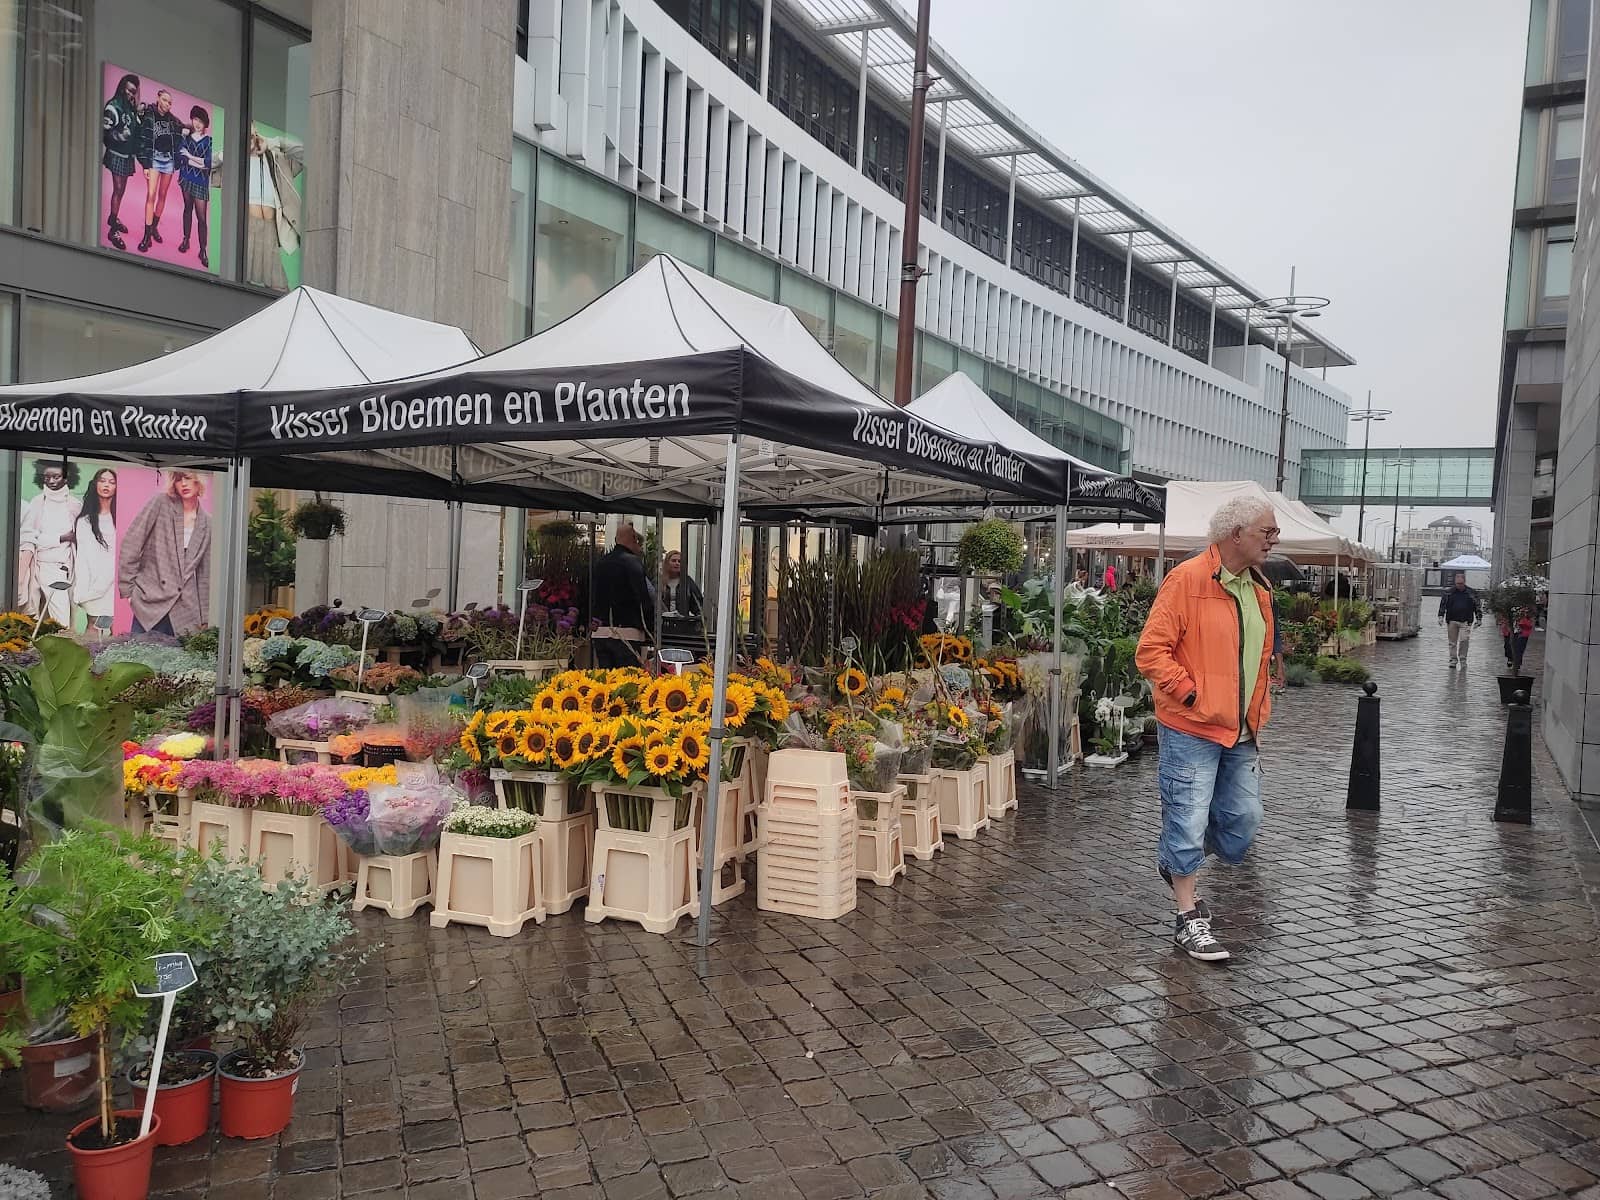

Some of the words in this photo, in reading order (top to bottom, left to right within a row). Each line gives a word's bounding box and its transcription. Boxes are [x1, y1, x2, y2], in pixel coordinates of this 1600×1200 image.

[0, 402, 84, 434] Bloemen
[90, 408, 117, 436] en
[120, 405, 208, 441] Planten
[270, 404, 350, 440] Visser
[359, 393, 493, 433] Bloemen
[503, 390, 544, 425] en
[554, 378, 690, 423] Planten
[852, 406, 904, 450] Visser
[906, 418, 968, 468] Bloemen
[967, 446, 984, 473] en
[984, 444, 1026, 483] Planten
